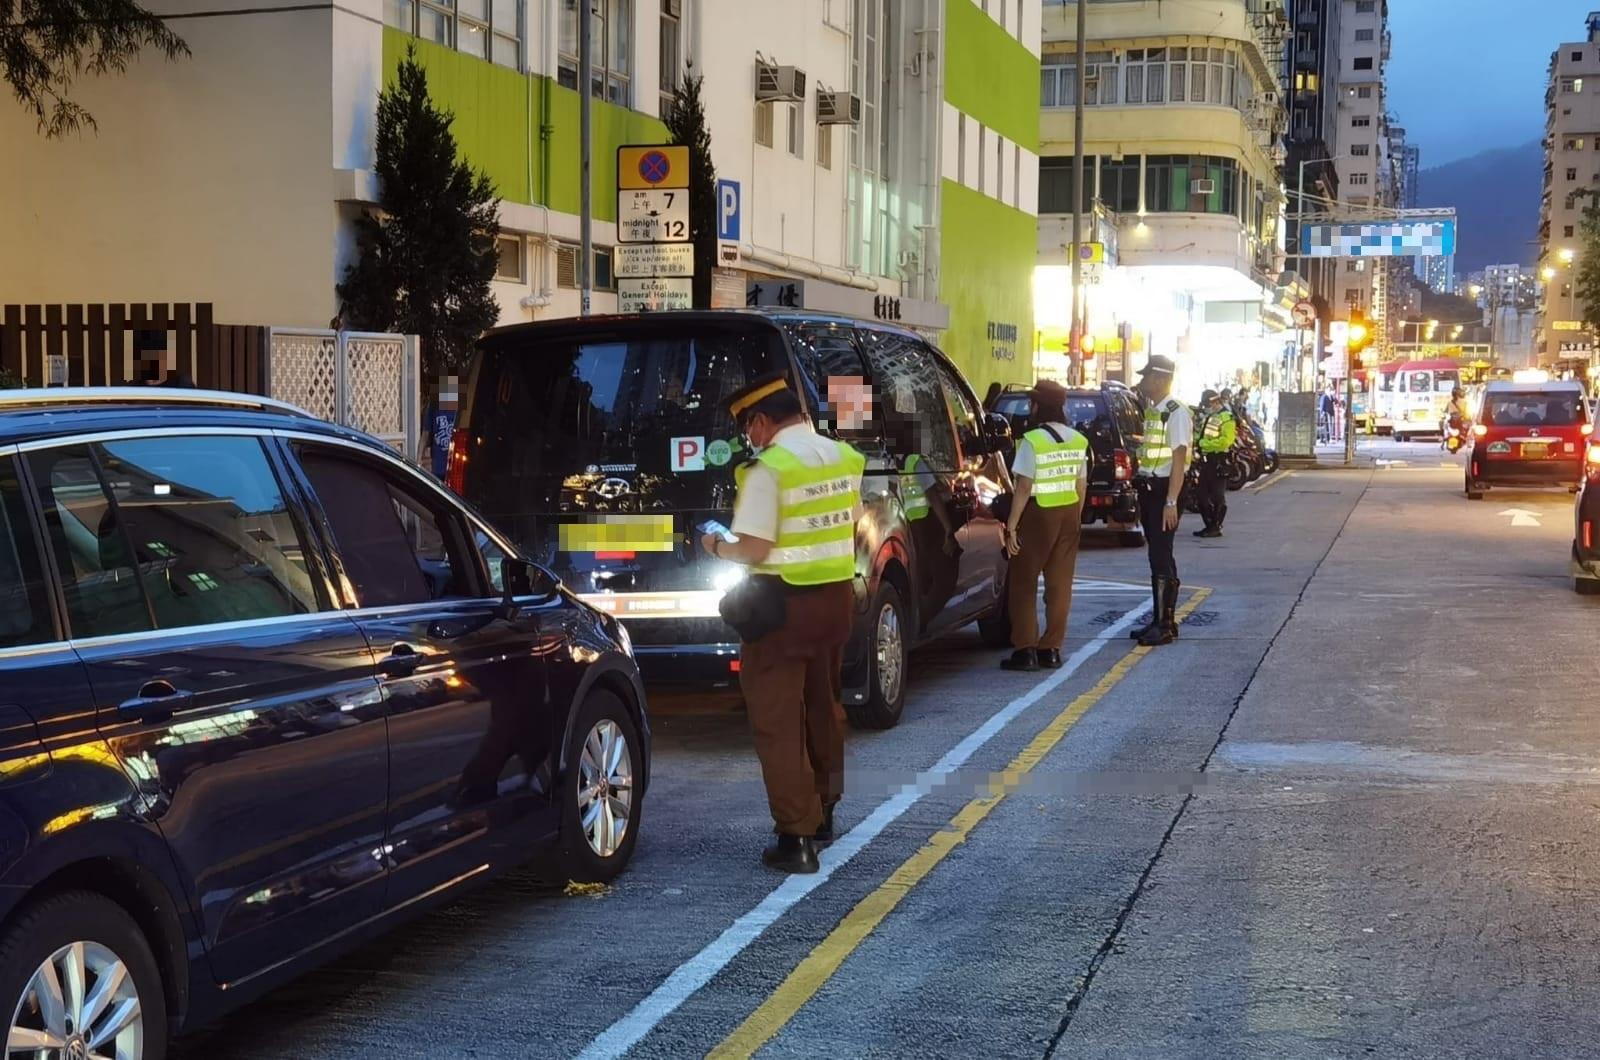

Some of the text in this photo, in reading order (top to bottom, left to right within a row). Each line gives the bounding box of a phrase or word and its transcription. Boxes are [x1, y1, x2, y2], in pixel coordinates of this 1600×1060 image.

[631, 200, 651, 210] 上午
[664, 192, 675, 209] 7
[722, 185, 736, 234] P
[623, 219, 659, 228] midnight
[664, 220, 685, 238] 12
[618, 248, 642, 256] Except
[1090, 264, 1096, 272] 7
[641, 282, 667, 291] Except
[622, 290, 688, 299] General Holidays
[679, 441, 698, 467] P
